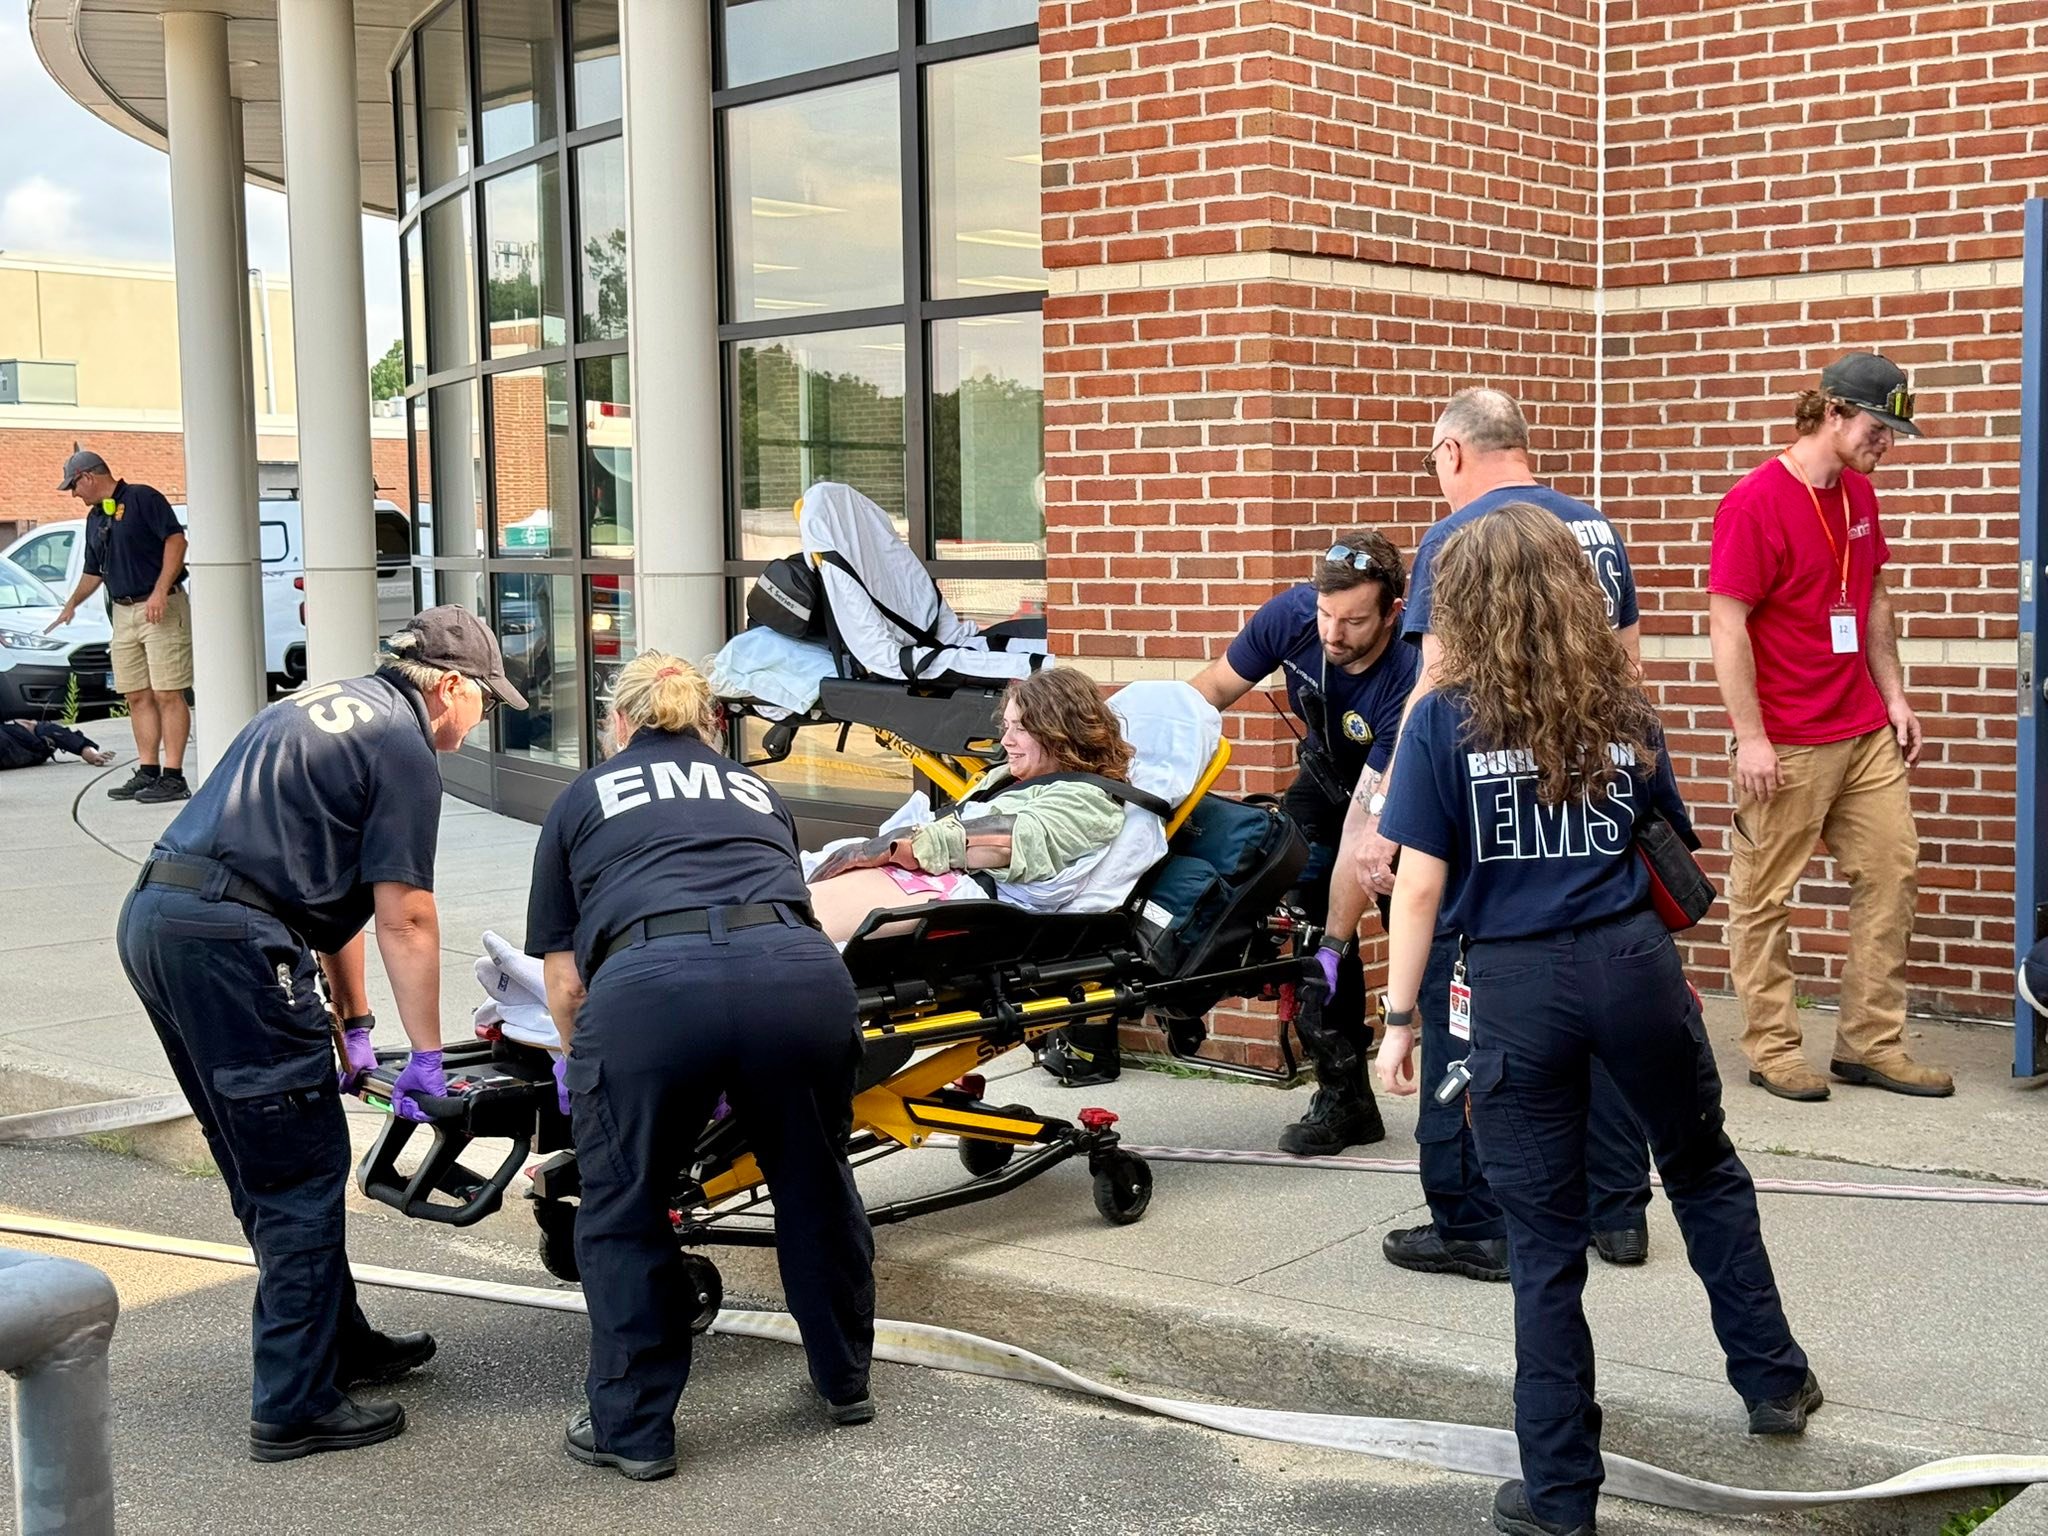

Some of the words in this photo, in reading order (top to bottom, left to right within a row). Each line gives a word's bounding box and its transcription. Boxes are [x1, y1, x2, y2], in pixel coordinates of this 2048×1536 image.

[767, 585, 775, 593] X
[774, 590, 795, 609] Series
[1839, 625, 1848, 634] 12
[277, 683, 375, 734] MS
[1467, 742, 1636, 777] BURLON
[595, 761, 774, 820] EMS
[1471, 768, 1635, 862] EMS
